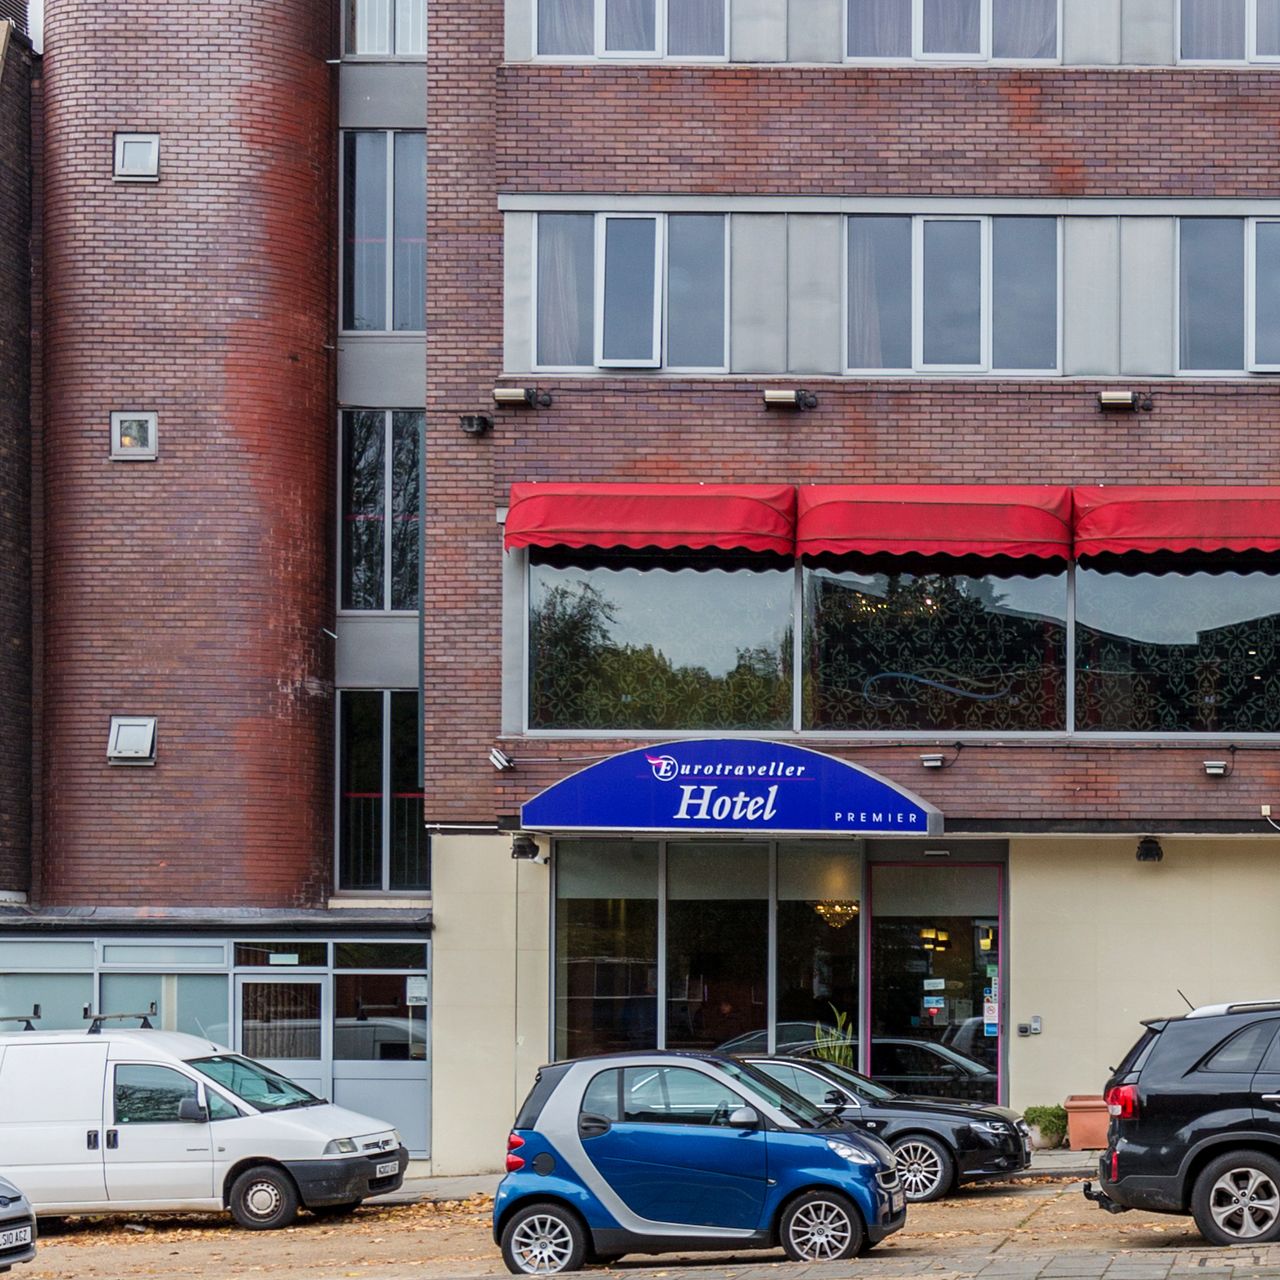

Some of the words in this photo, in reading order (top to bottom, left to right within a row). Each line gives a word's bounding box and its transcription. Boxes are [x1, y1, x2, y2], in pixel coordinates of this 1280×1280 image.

[657, 759, 806, 777] Eurotraveller
[672, 784, 779, 821] Hotel
[834, 811, 918, 823] PREMIER
